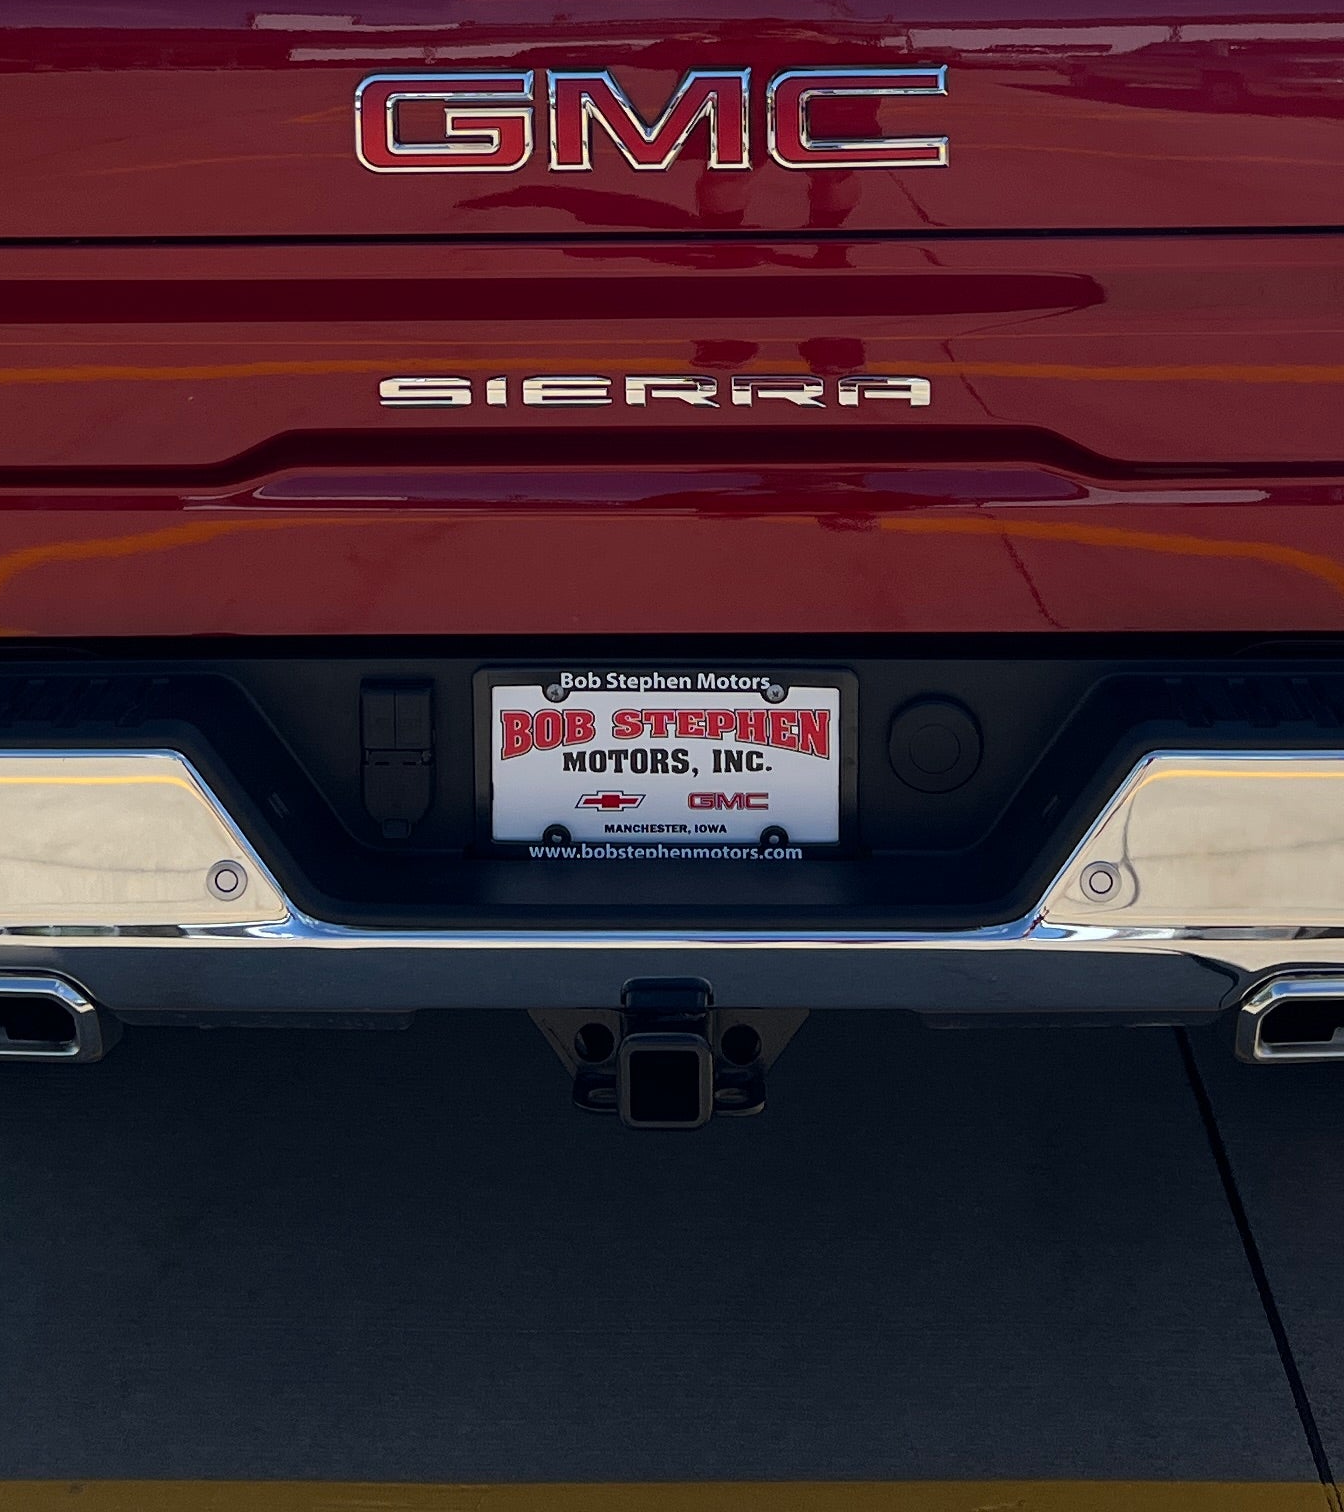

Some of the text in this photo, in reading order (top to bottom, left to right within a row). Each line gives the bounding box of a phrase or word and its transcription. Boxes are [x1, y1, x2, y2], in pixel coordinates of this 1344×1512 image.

[354, 64, 949, 174] GMC
[379, 375, 931, 408] SIERRA
[560, 672, 771, 693] Bob Stephen Motors
[500, 708, 831, 761] BOB STEPHEN
[562, 748, 773, 778] MOTORS, INC.
[687, 791, 770, 811] GMC
[604, 824, 727, 835] MANCHESTER, IOWA
[528, 843, 803, 861] www.bobstephenmotors.com
